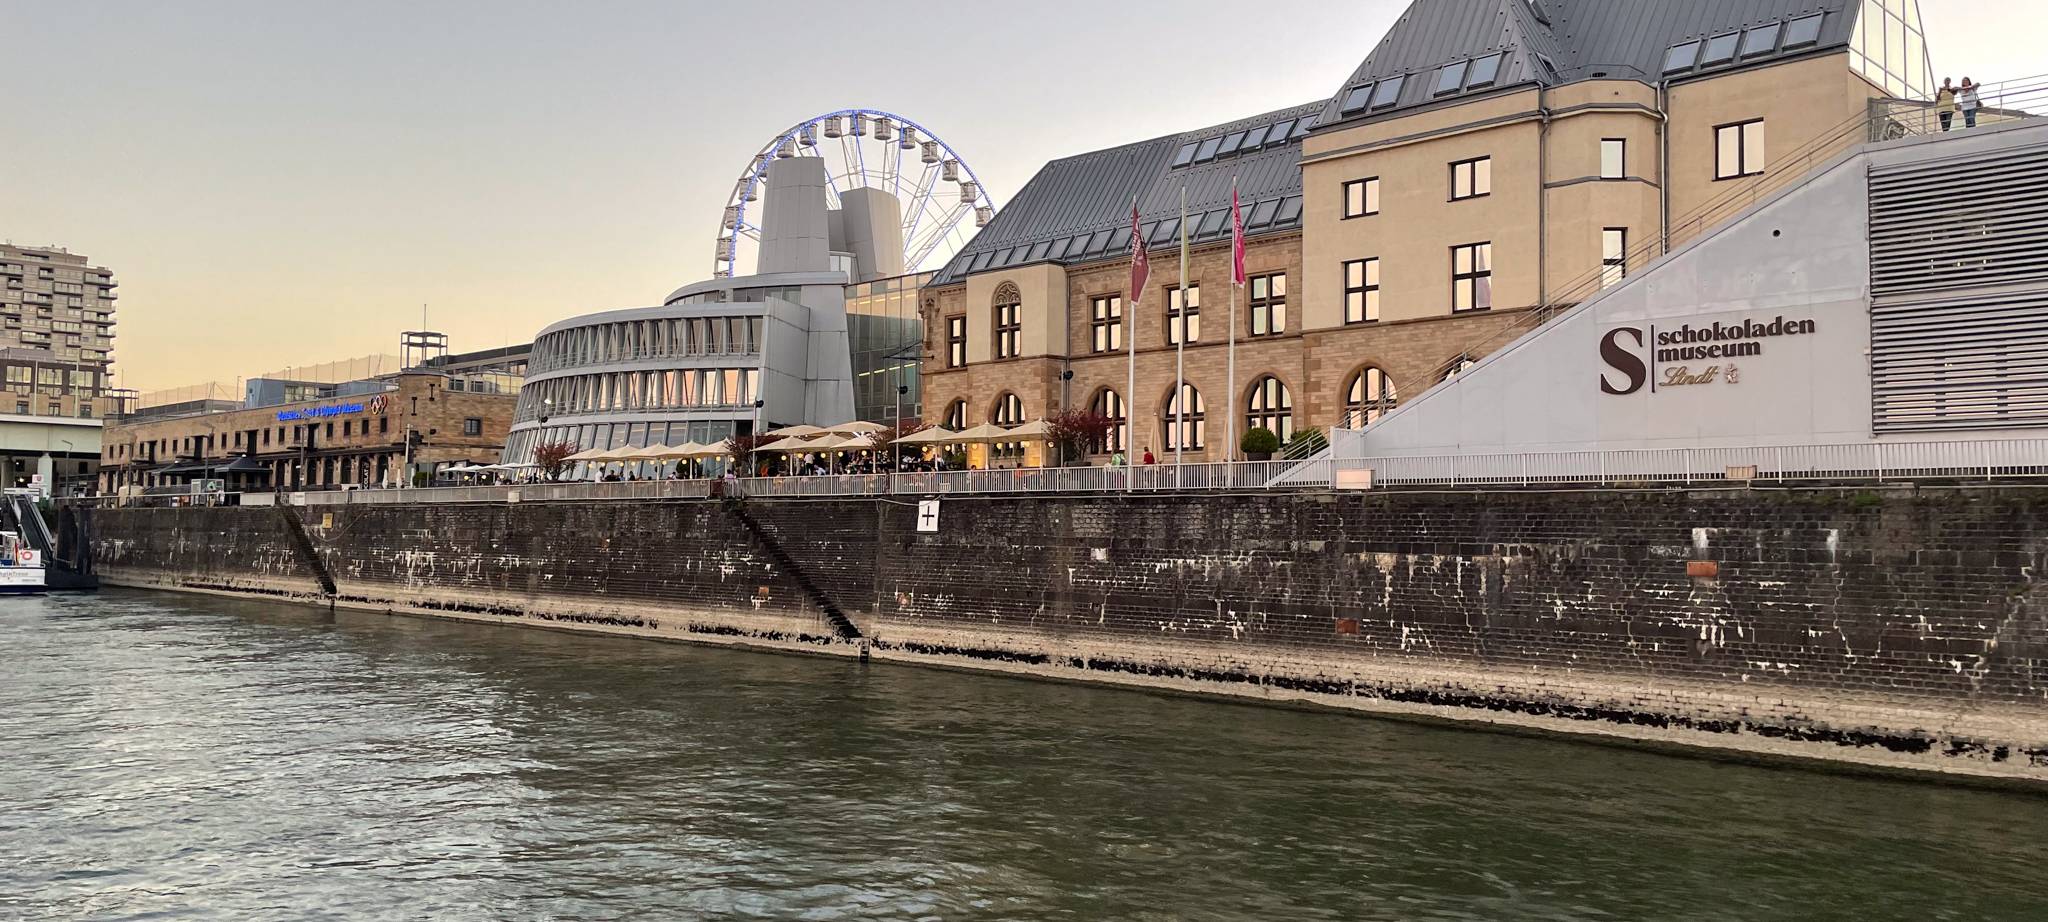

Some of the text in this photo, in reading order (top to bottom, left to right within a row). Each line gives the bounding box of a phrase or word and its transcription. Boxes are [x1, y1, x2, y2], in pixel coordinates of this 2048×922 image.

[1657, 316, 1815, 346] schokoladen
[1599, 327, 1646, 395] S
[1657, 340, 1761, 362] museum
[1659, 365, 1718, 387] Lindt
